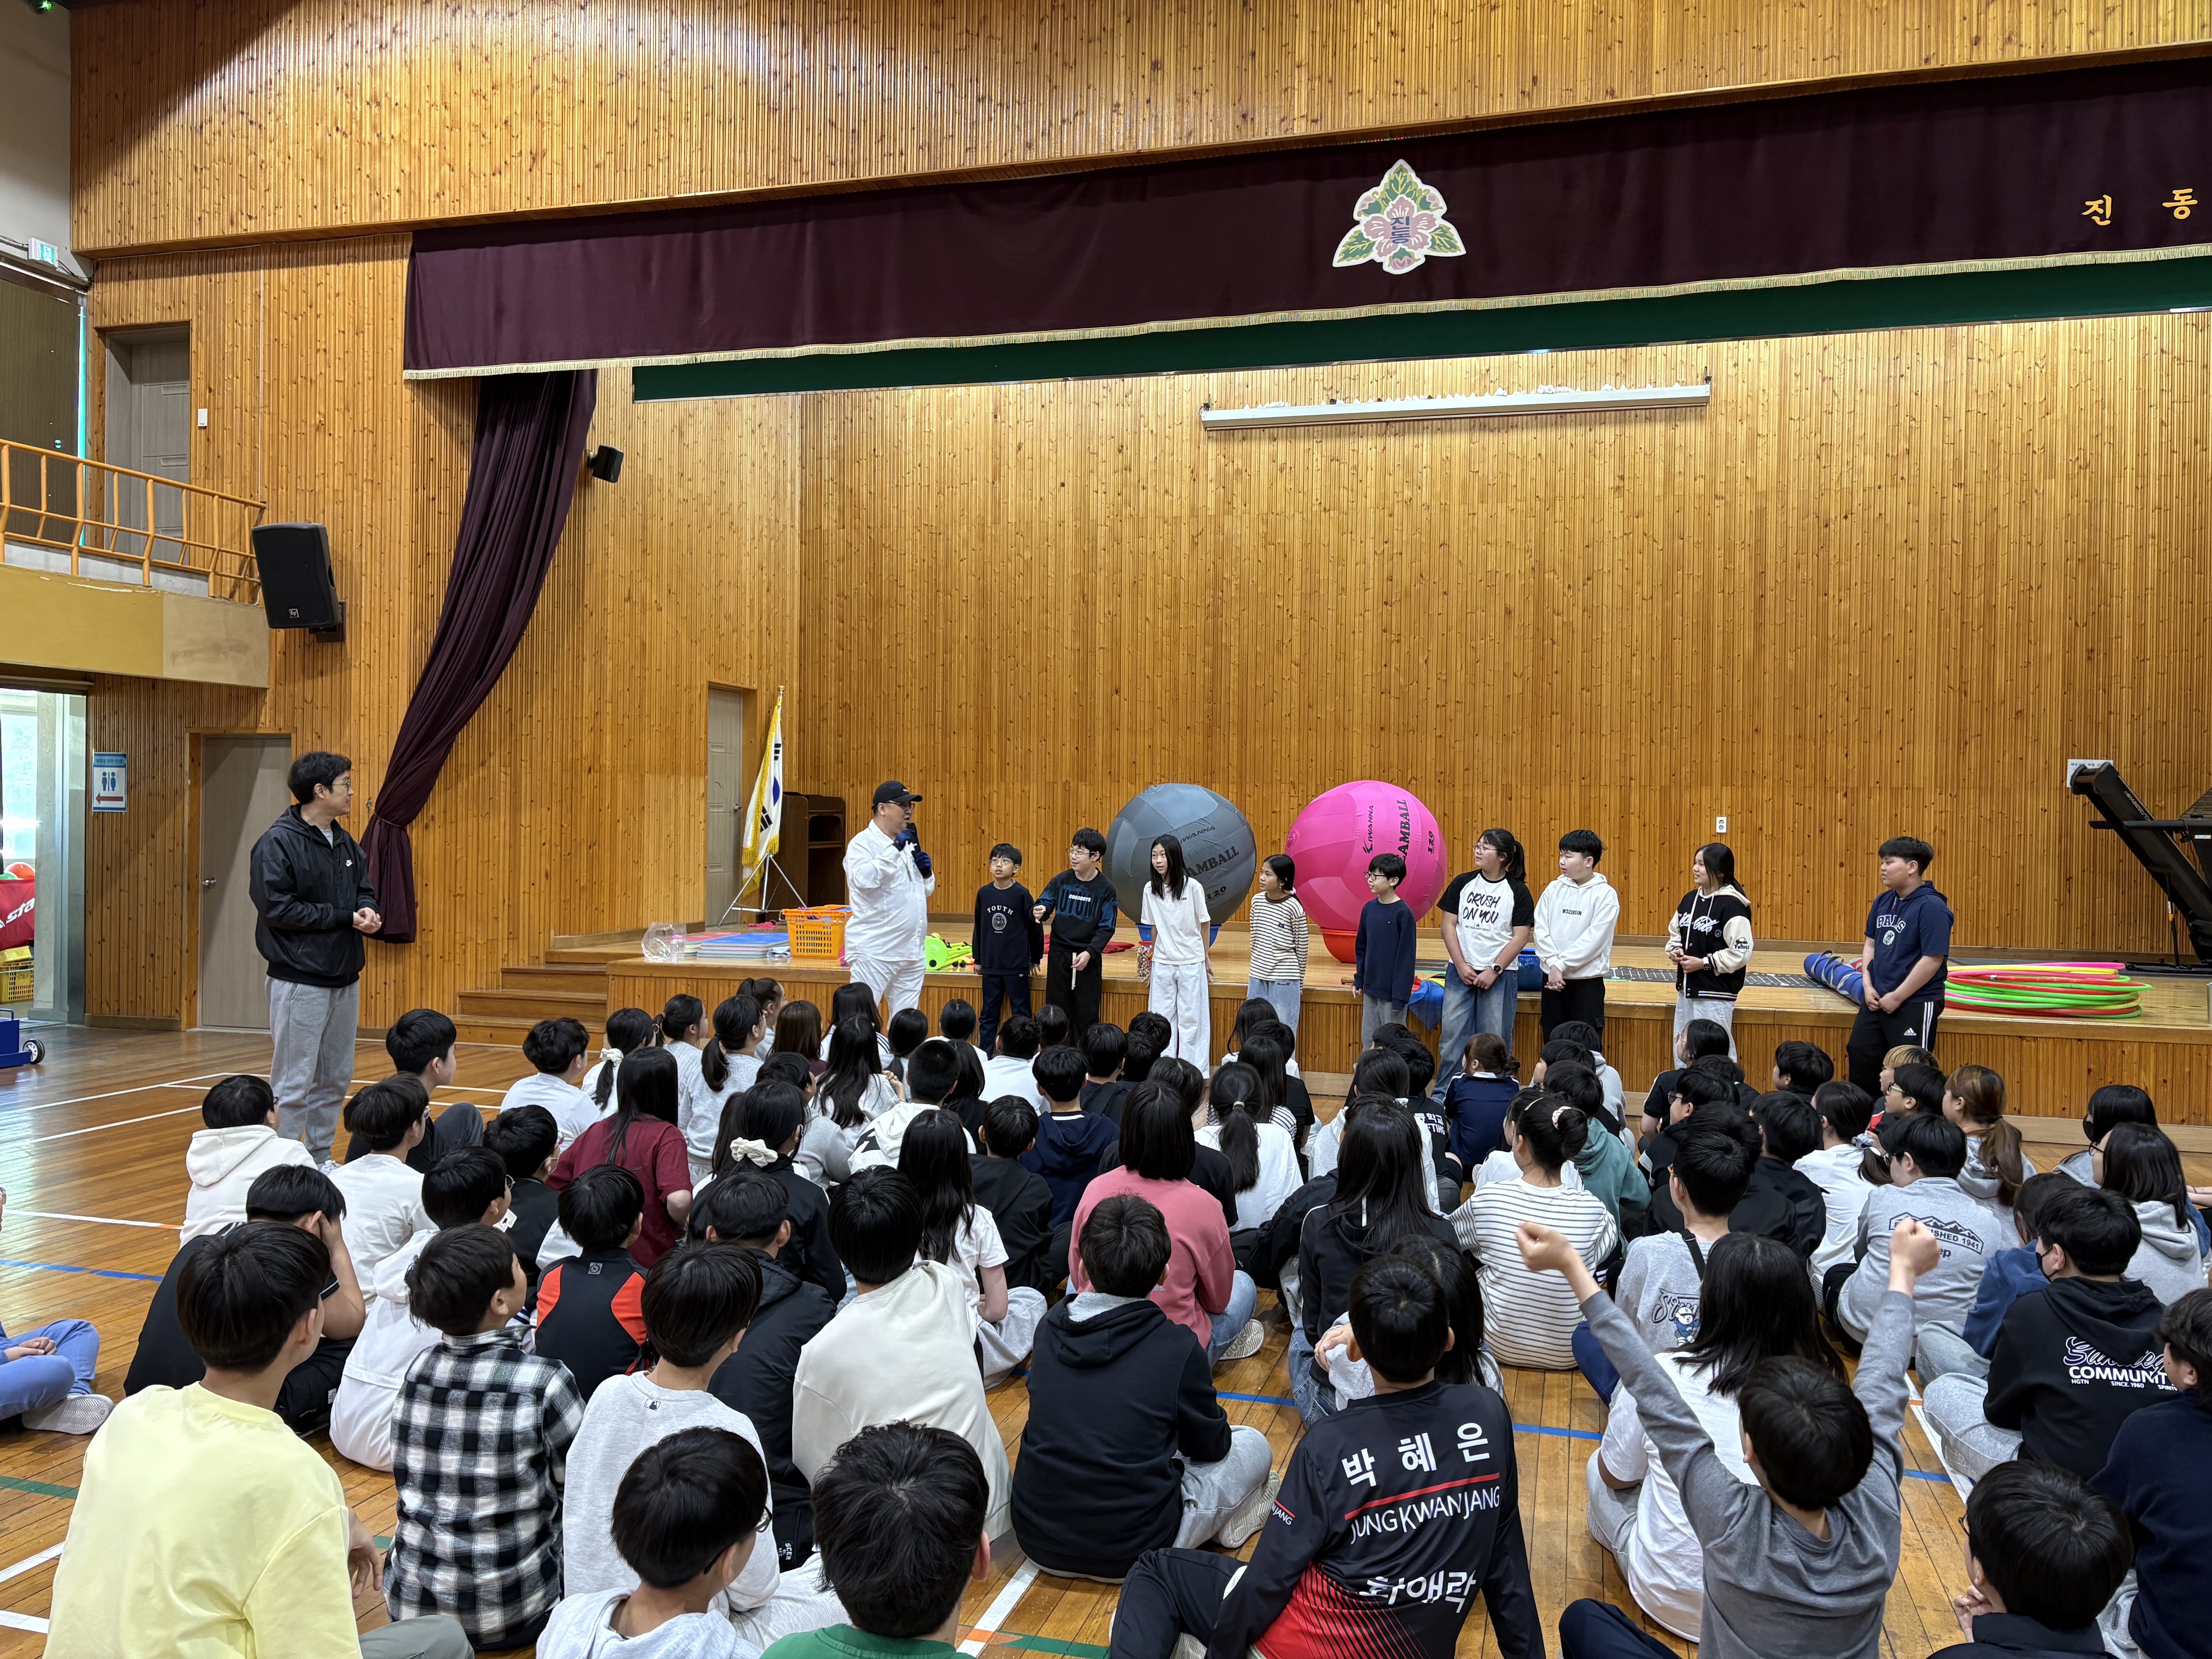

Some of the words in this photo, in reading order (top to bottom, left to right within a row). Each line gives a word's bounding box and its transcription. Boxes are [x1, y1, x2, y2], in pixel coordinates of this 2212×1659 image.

[1180, 826, 1216, 844] IWANNA
[1187, 846, 1239, 876] AMBALL
[1206, 886, 1226, 900] 120
[1467, 891, 1501, 908] CRUSH
[987, 905, 1013, 915] YOUTH
[1463, 906, 1479, 921] ON
[1479, 909, 1499, 924] YOU
[1962, 1238, 1979, 1250] 1941
[2069, 1366, 2172, 1386] COMMUNIT
[1350, 1486, 1500, 1545] JUNGKWANJANG
